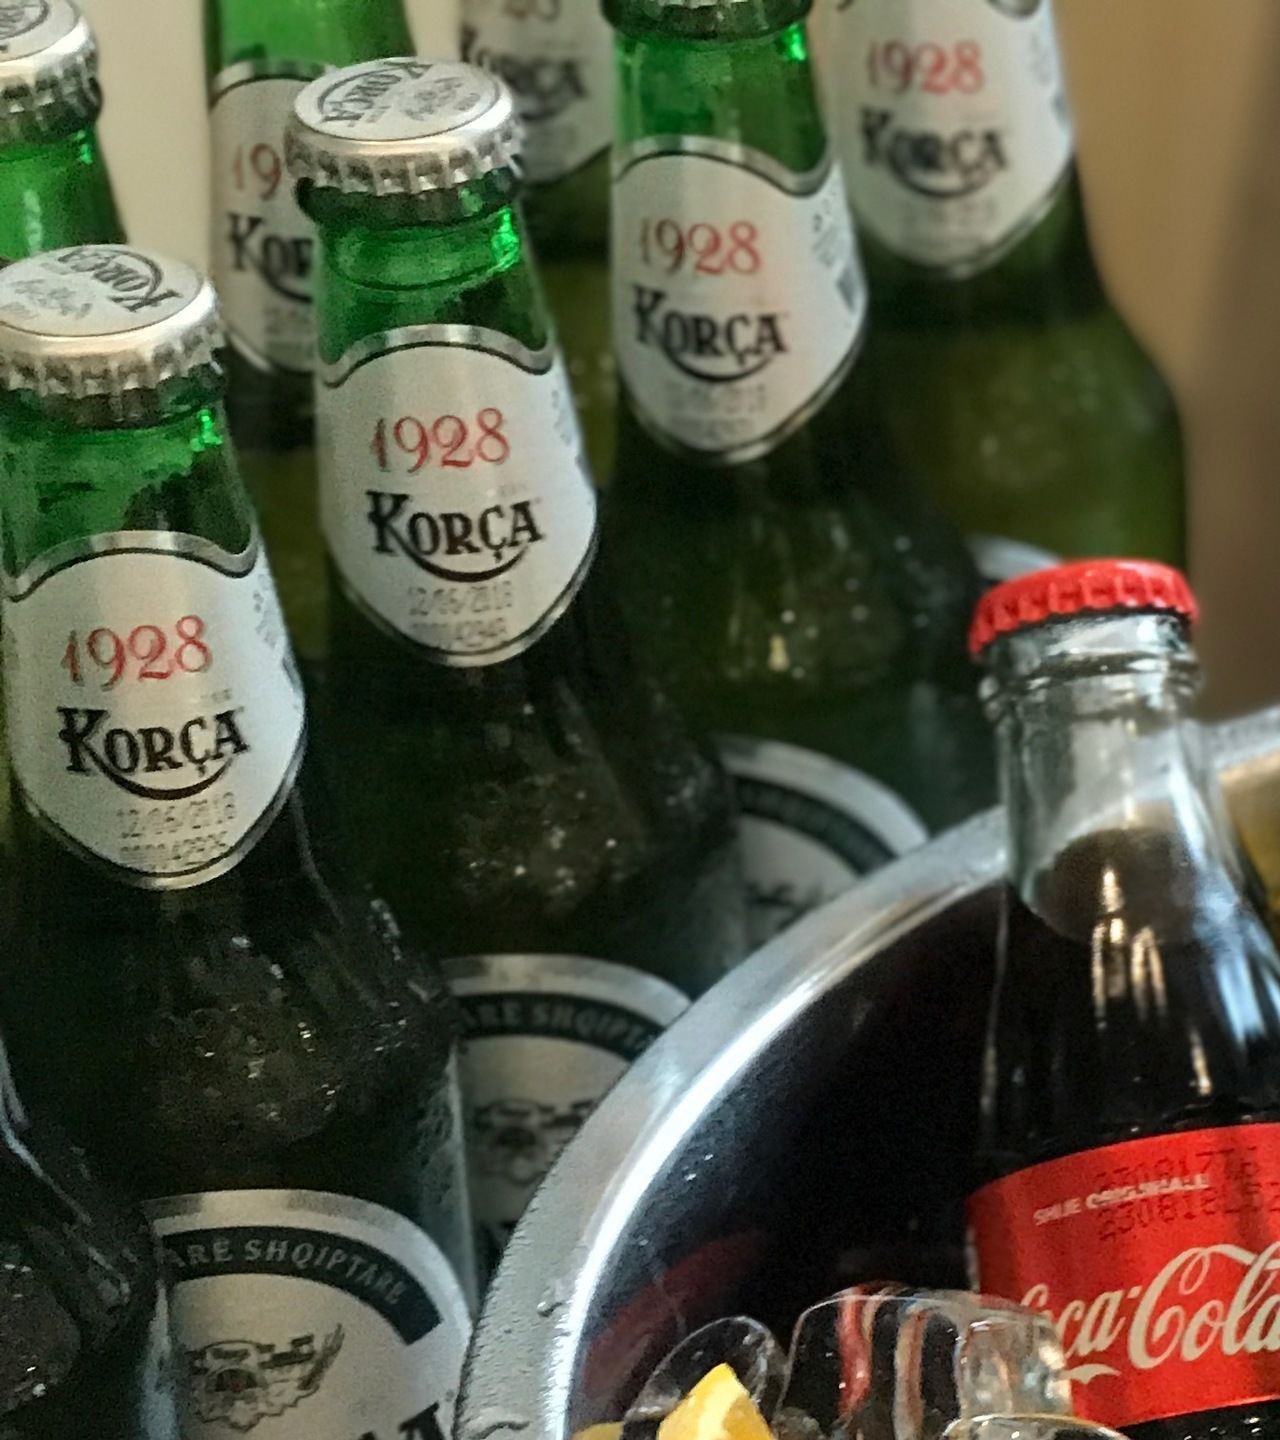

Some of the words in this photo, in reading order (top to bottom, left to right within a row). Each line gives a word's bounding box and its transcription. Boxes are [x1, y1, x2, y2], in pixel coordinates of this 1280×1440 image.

[868, 40, 985, 95] 1928
[860, 104, 1007, 183] KORÇA
[640, 218, 762, 276] 1928
[632, 283, 788, 367] KORÇA
[370, 407, 510, 475] 1928
[366, 490, 544, 562] KORÇA
[62, 614, 214, 688] 1928
[57, 706, 250, 778] KORÇA
